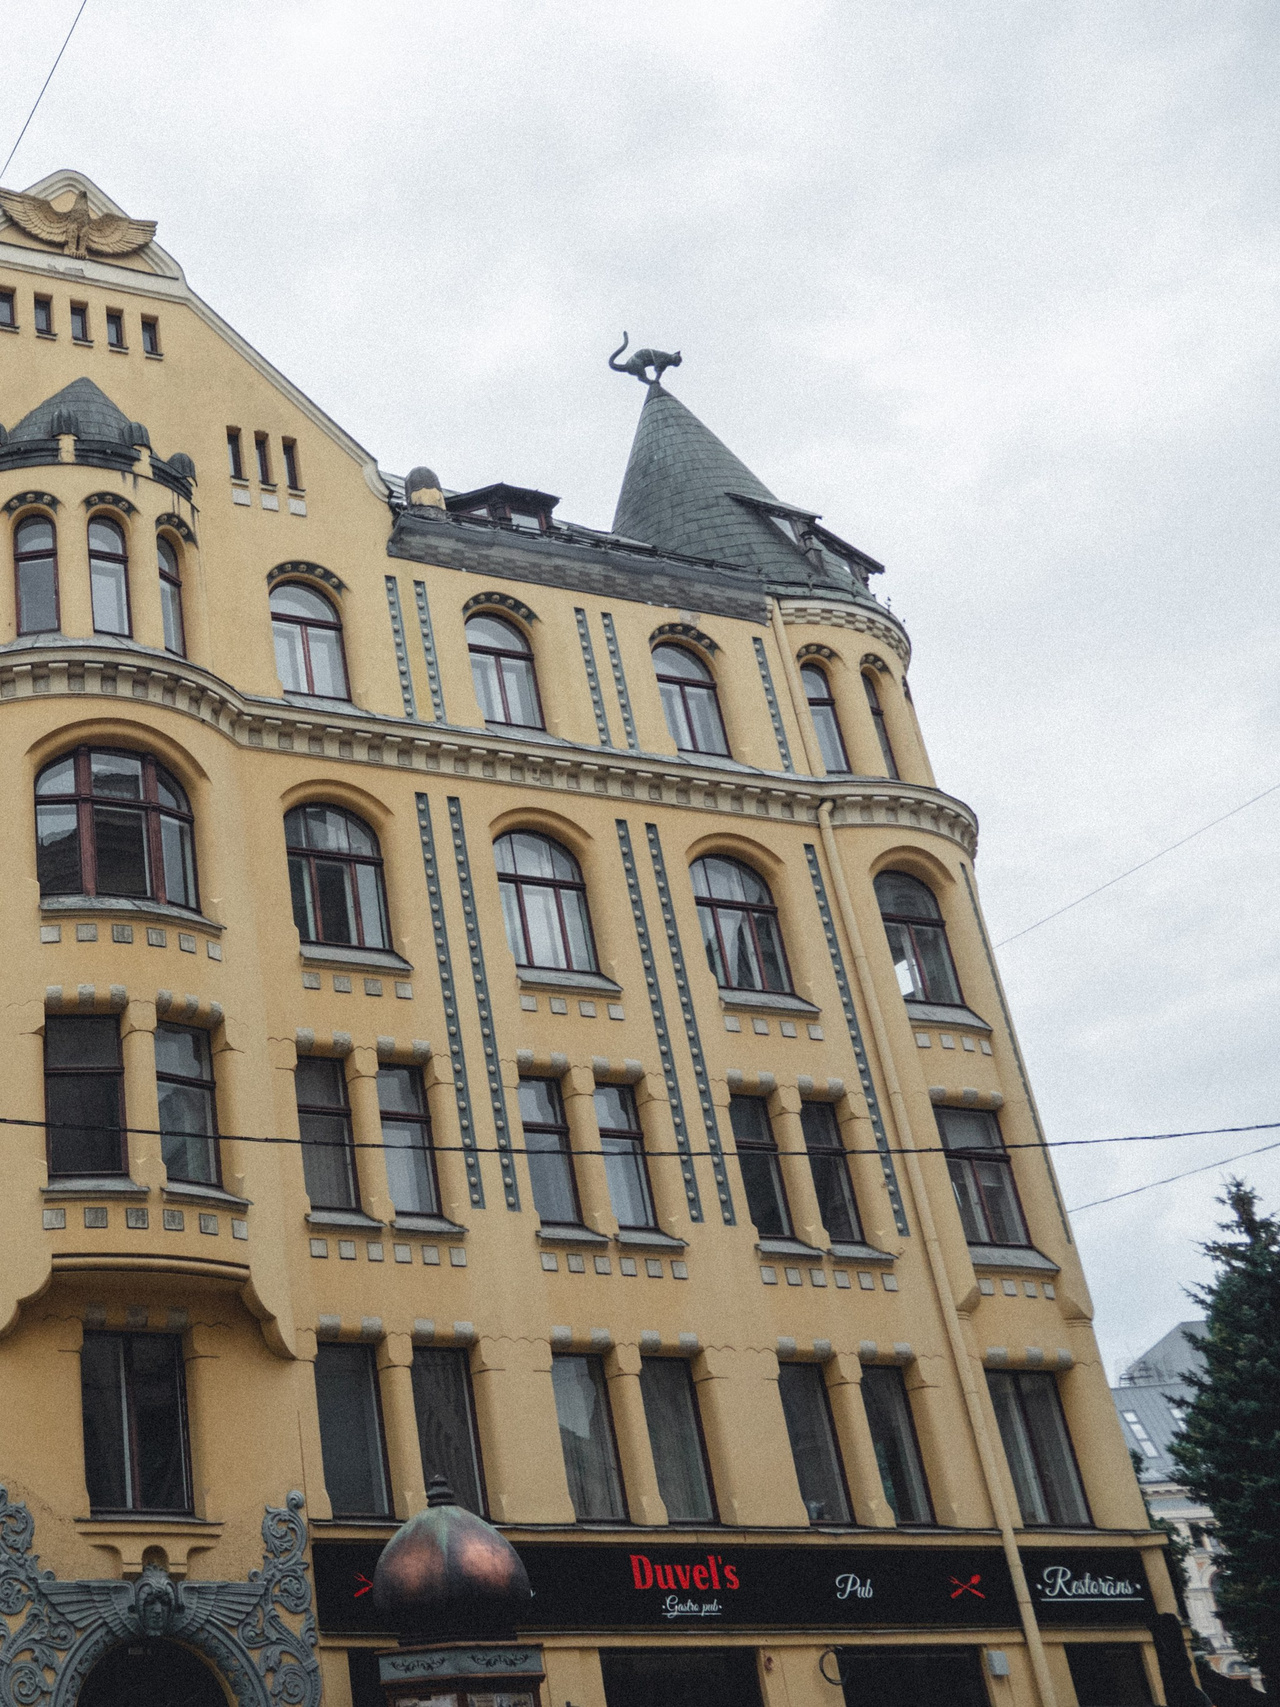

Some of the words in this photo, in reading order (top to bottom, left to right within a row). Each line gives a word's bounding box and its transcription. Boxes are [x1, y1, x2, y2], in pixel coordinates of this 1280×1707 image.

[629, 1554, 740, 1590] Duvel's
[834, 1573, 874, 1600] Pub
[1042, 1566, 1134, 1597] Restorāns
[664, 1595, 700, 1619] Gastro
[700, 1599, 719, 1617] pub
